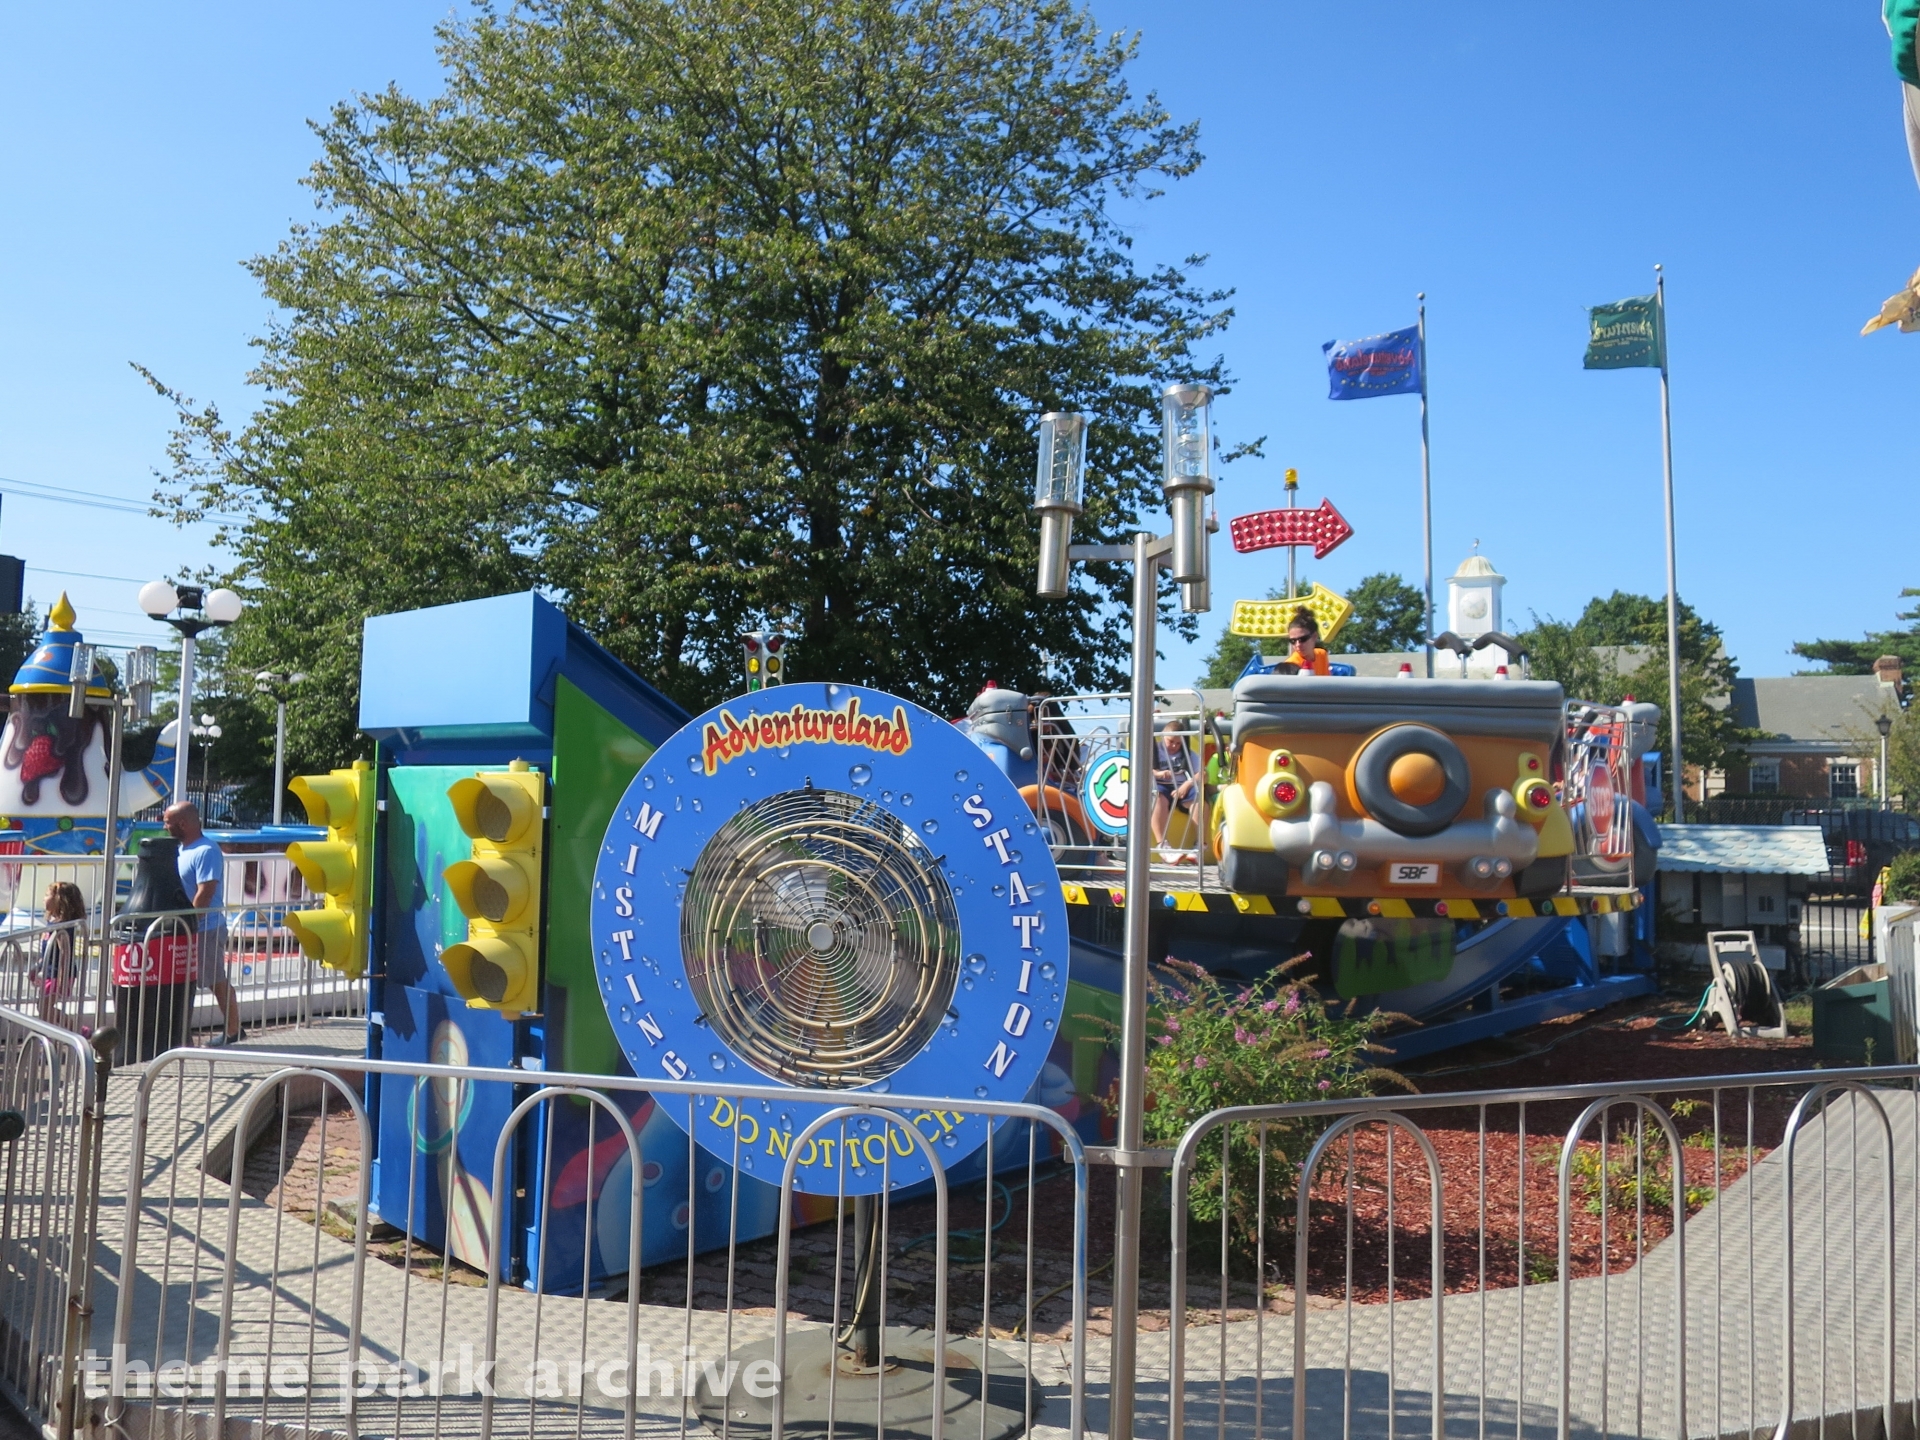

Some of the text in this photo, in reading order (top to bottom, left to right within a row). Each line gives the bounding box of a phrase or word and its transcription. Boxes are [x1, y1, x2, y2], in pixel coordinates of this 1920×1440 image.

[703, 697, 912, 776] Adventureland
[1591, 786, 1611, 817] STOP
[1398, 866, 1429, 879] SBF
[611, 801, 688, 1081] MISTING
[962, 794, 1038, 1078] STATION
[709, 1096, 965, 1168] DO NOT TOUCH
